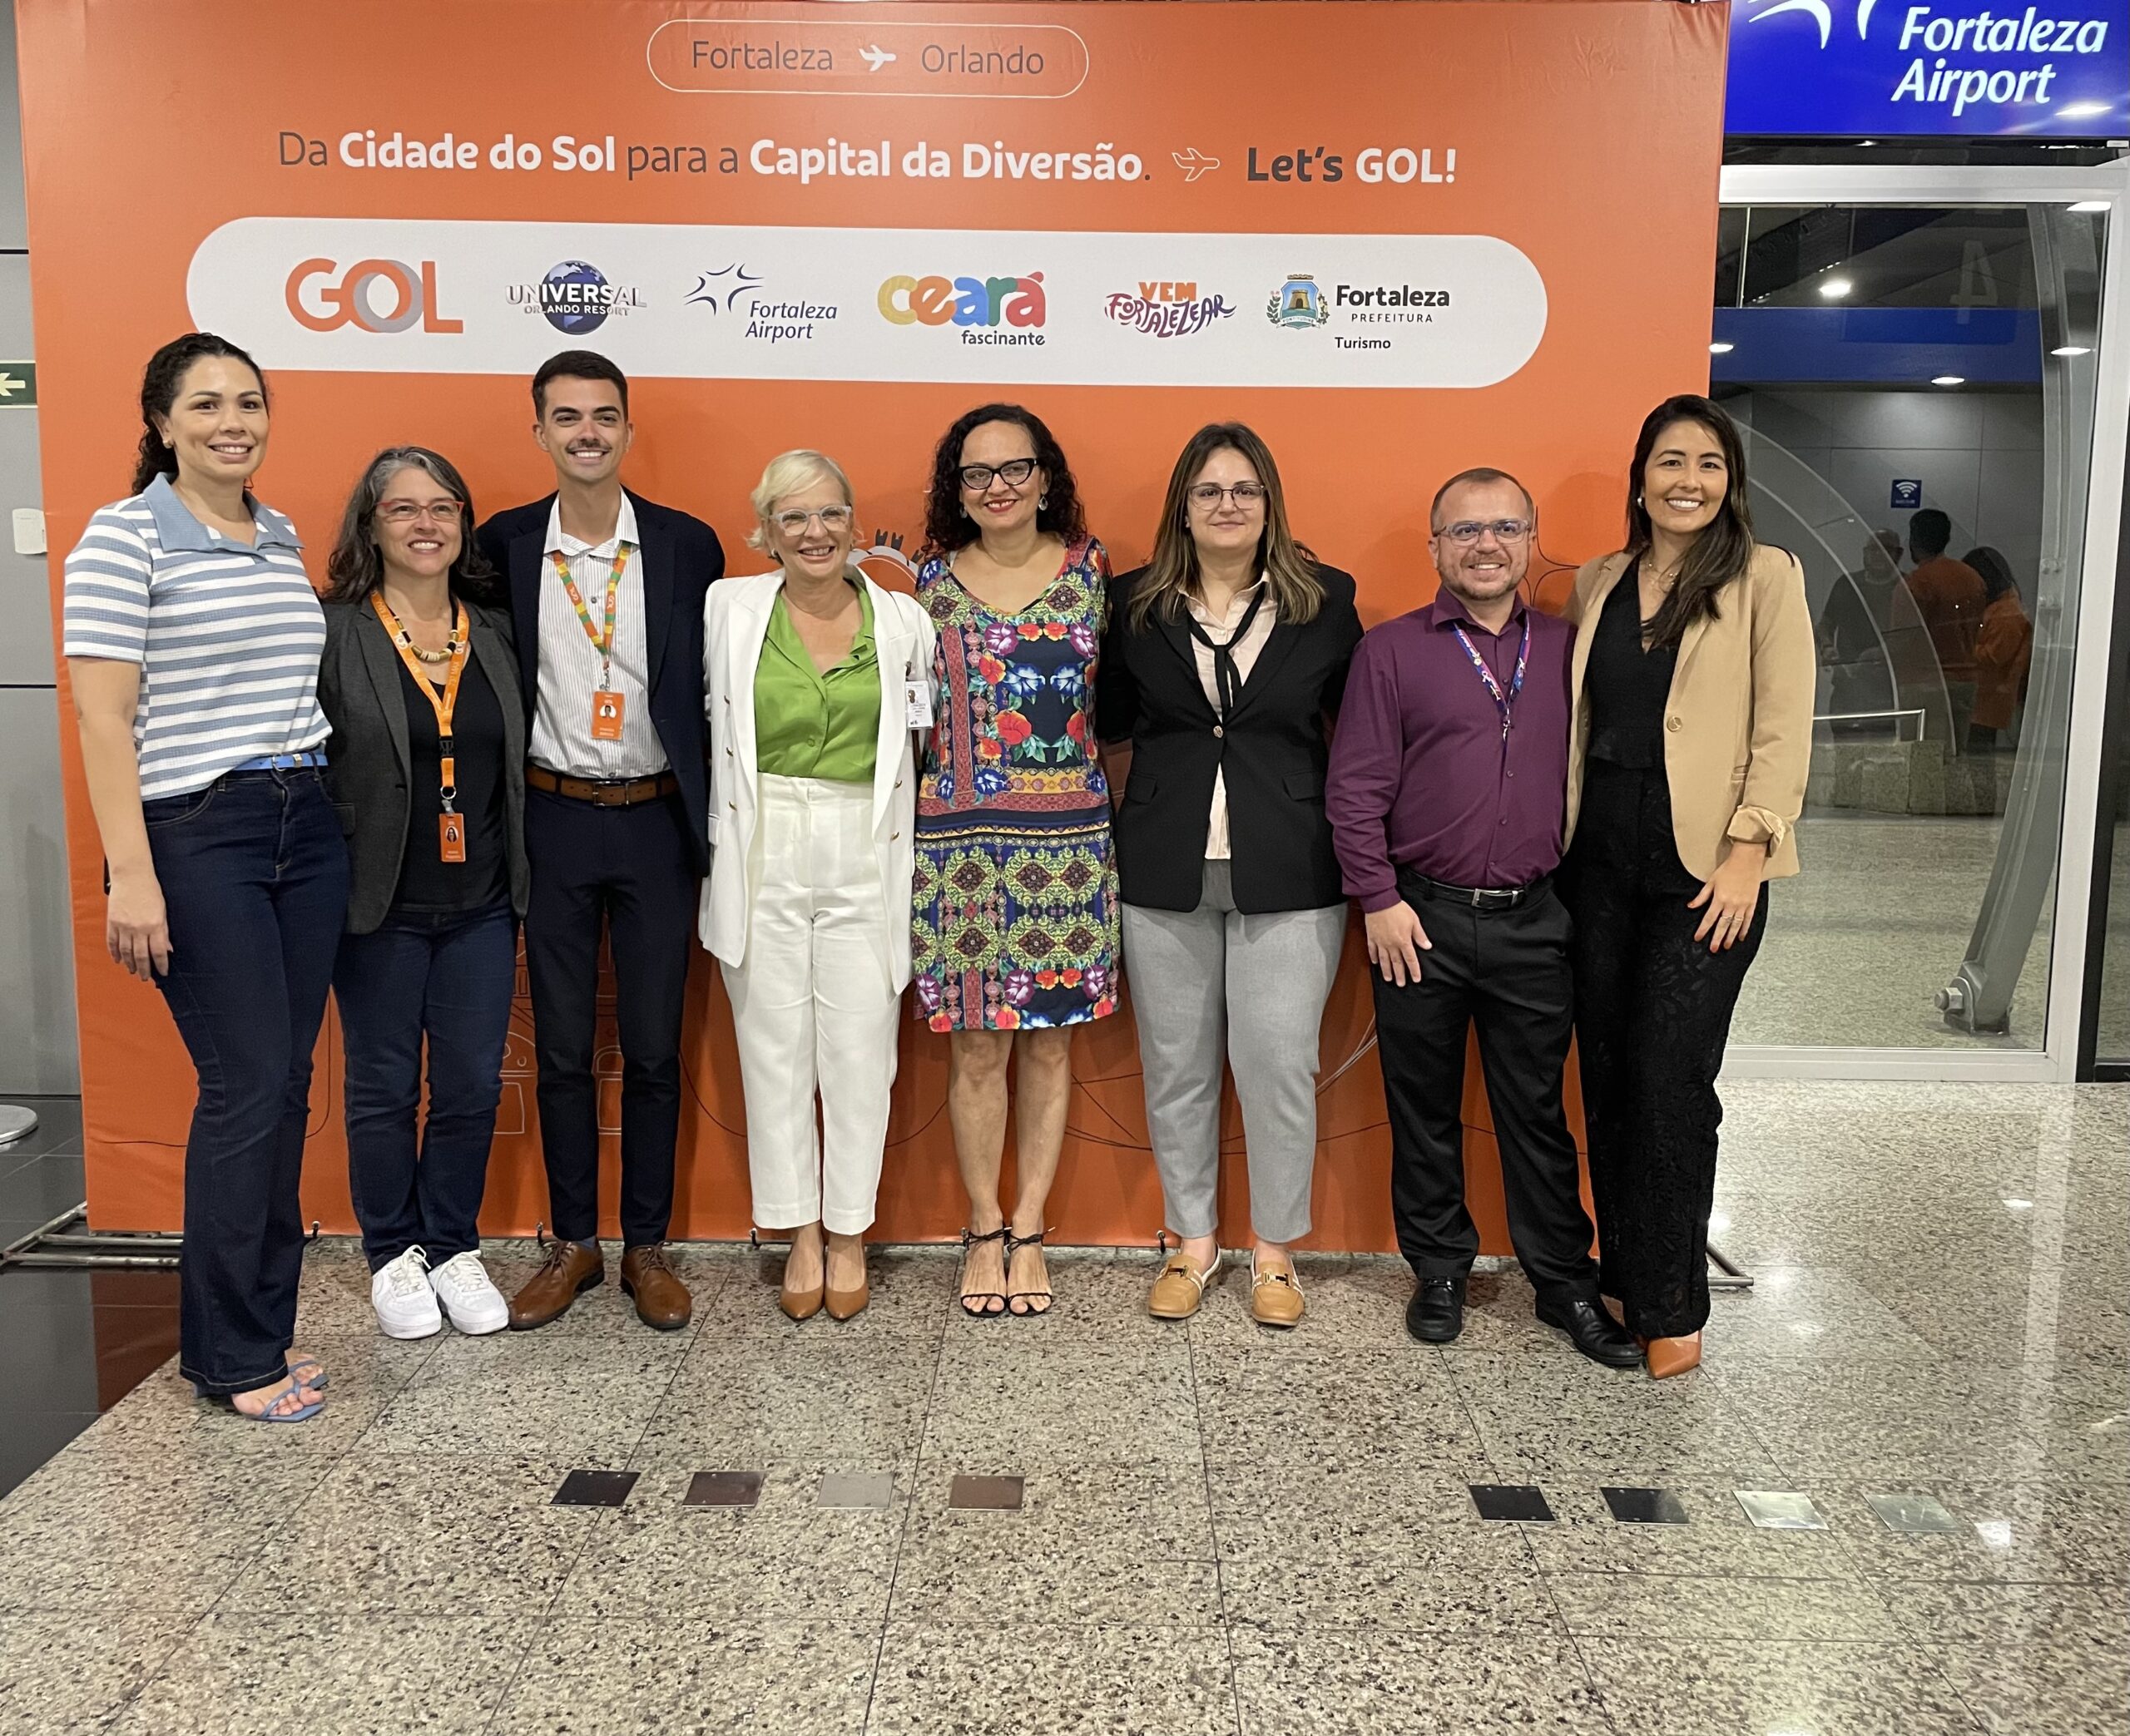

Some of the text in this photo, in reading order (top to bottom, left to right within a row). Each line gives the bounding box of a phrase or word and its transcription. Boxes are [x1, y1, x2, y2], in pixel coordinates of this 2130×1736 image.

[1898, 7, 2108, 53] Fortaleza
[693, 40, 1043, 74] Fortaleza Orlando
[1890, 58, 2056, 116] Airport
[280, 130, 1455, 184] Da Cidade do Sol para a Capital da Diversão. Let's GOL!
[285, 257, 463, 334] GOL
[505, 283, 647, 308] UNIVERSAL
[878, 271, 1047, 328] ceará
[1138, 281, 1196, 302] VEM
[1337, 284, 1449, 306] Fortaleza
[524, 304, 630, 316] ORLANDO RESORT
[750, 300, 837, 319] Fortaleza
[1105, 293, 1236, 338] FORTALEZEAR
[1351, 313, 1432, 322] PREFEITURA
[746, 320, 813, 343] Airport
[962, 329, 1045, 345] fascinante
[1335, 336, 1390, 349] Turismo
[393, 631, 409, 650] GOL
